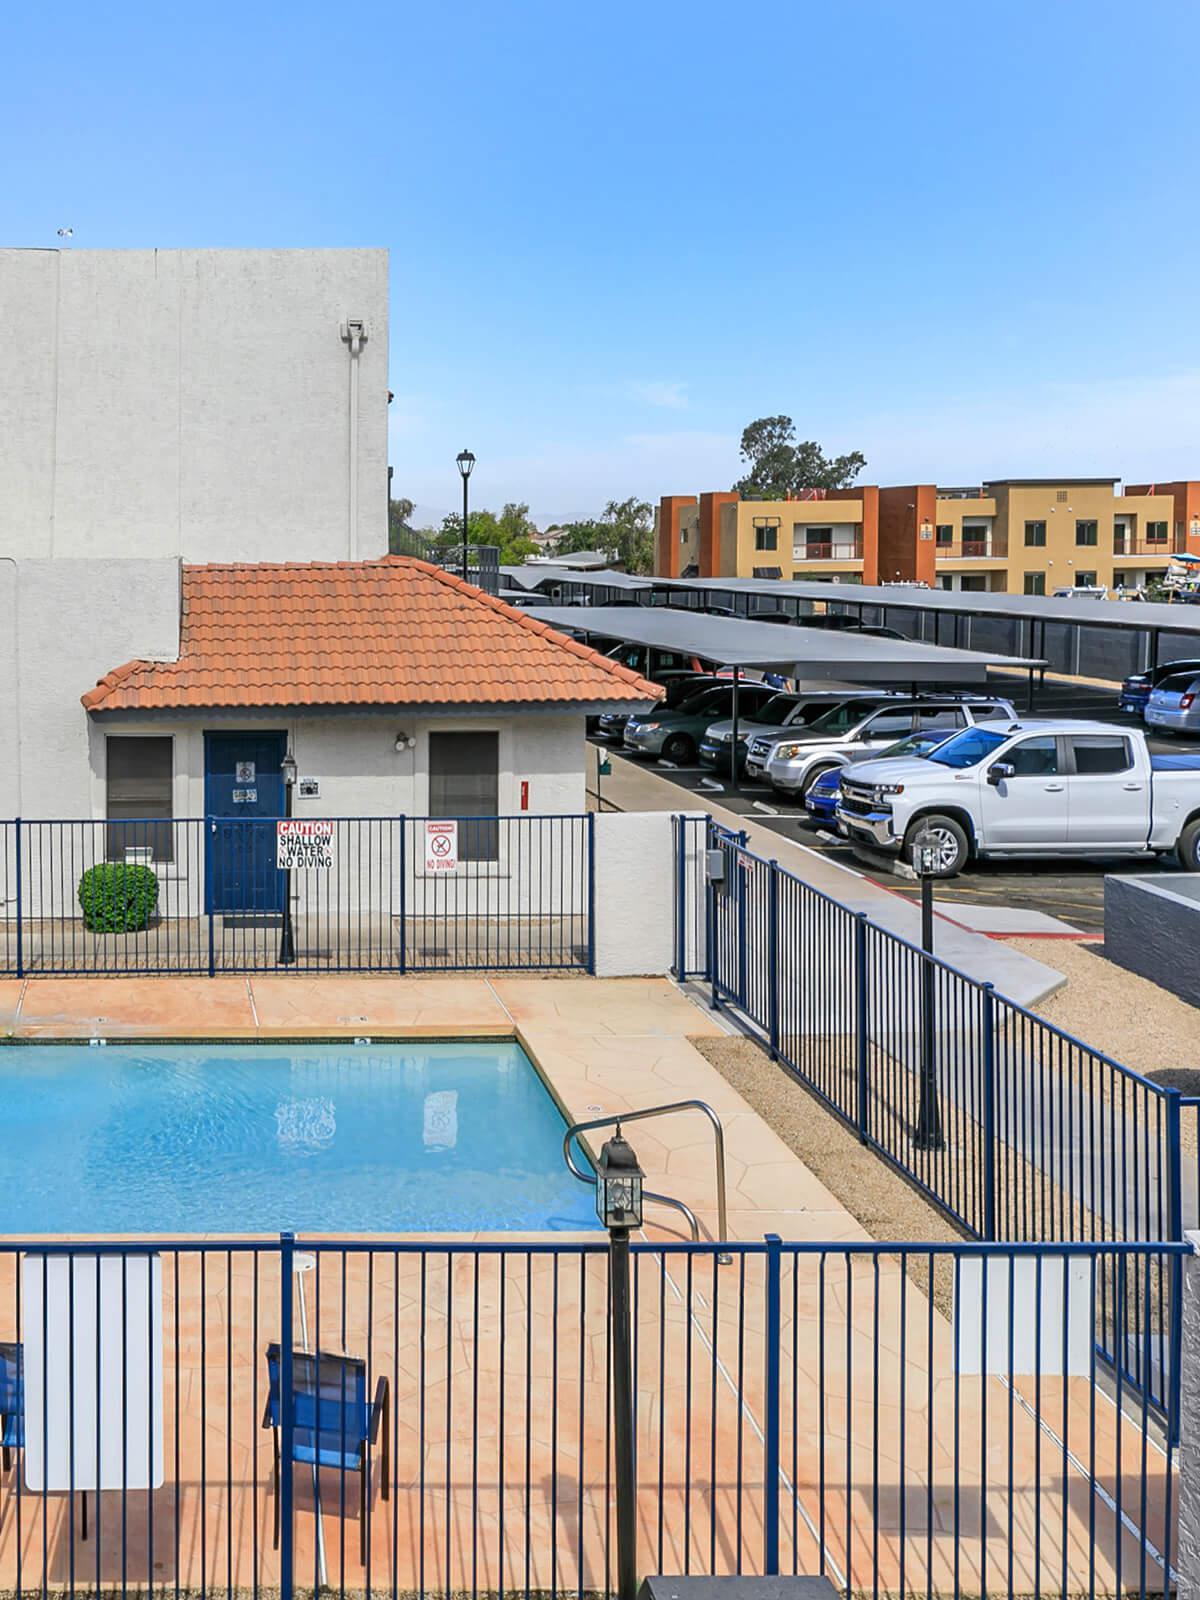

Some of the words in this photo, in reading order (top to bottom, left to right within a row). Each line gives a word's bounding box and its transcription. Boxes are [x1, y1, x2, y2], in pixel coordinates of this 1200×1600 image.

[280, 822, 332, 834] CAUTION
[280, 835, 331, 846] SHALLOW
[288, 846, 323, 857] WATER
[279, 856, 293, 868] NO
[297, 856, 332, 868] DIVING
[427, 859, 435, 870] NO
